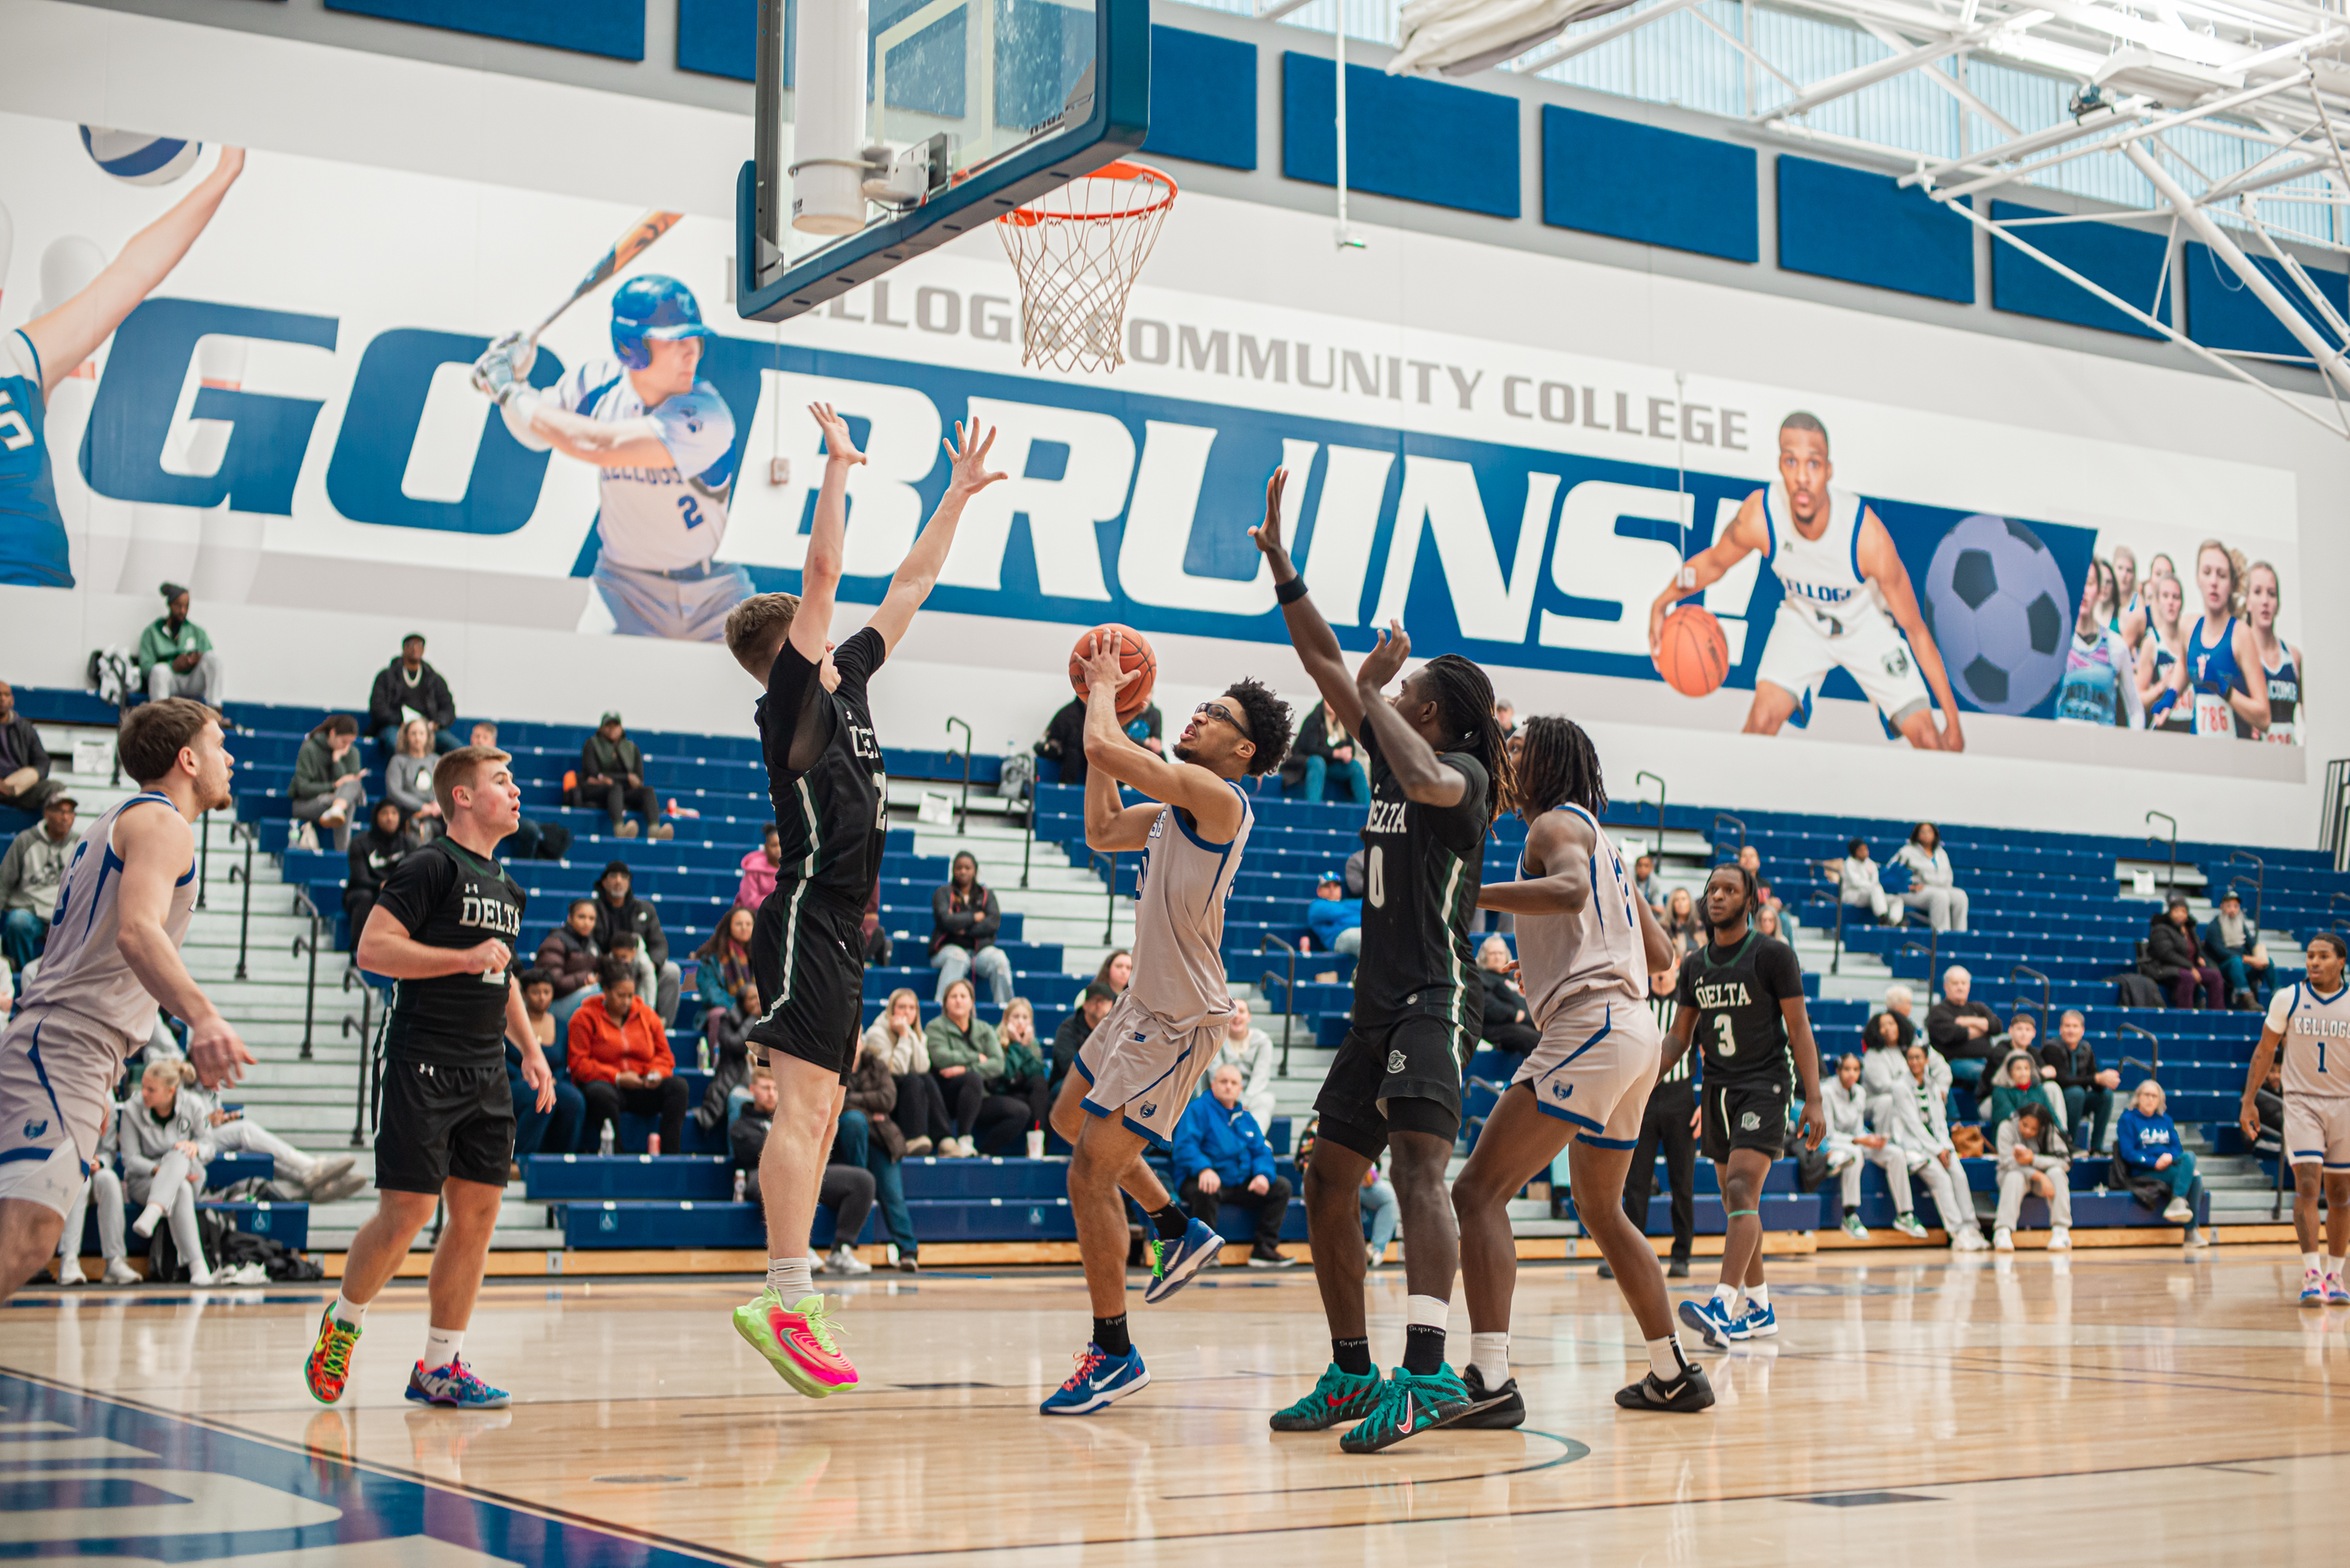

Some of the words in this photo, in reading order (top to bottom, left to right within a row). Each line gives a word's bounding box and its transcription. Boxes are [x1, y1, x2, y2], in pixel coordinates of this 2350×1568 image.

[1502, 373, 1750, 452] COLLEGE
[78, 297, 567, 536] GO
[712, 368, 1762, 666] BRUINS!
[678, 494, 704, 530] 2
[2200, 705, 2229, 733] 786
[1366, 798, 1408, 833] DELTA
[1368, 845, 1385, 909] 0
[459, 897, 521, 938] DELTA
[1695, 982, 1752, 1010] DELTA
[1713, 1013, 1737, 1057] 3
[2317, 1042, 2328, 1073] 1
